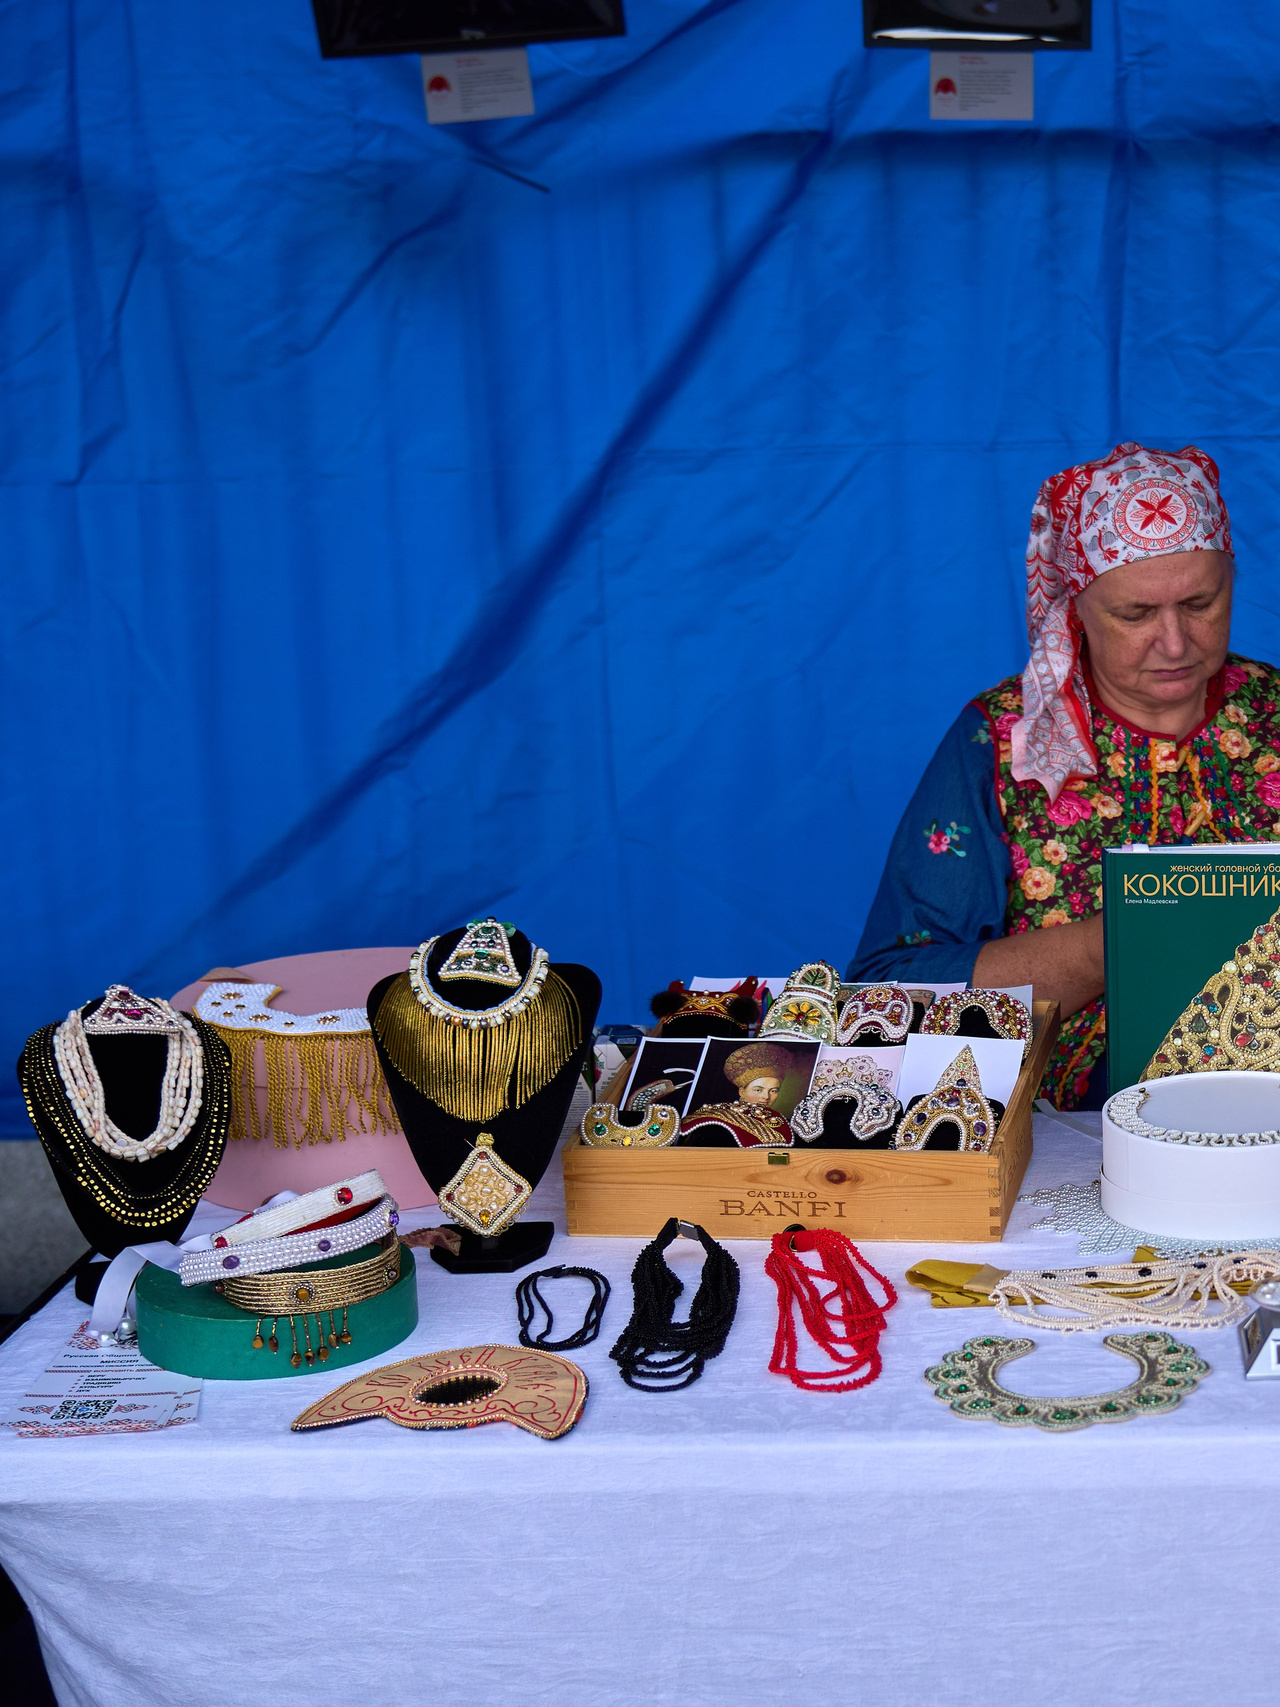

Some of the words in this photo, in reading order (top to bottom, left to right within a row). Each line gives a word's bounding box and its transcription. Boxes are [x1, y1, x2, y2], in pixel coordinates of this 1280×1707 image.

[1169, 863, 1213, 873] женский
[1214, 863, 1261, 873] головной
[747, 1190, 818, 1199] CASTELLO
[719, 1199, 847, 1218] BANFI
